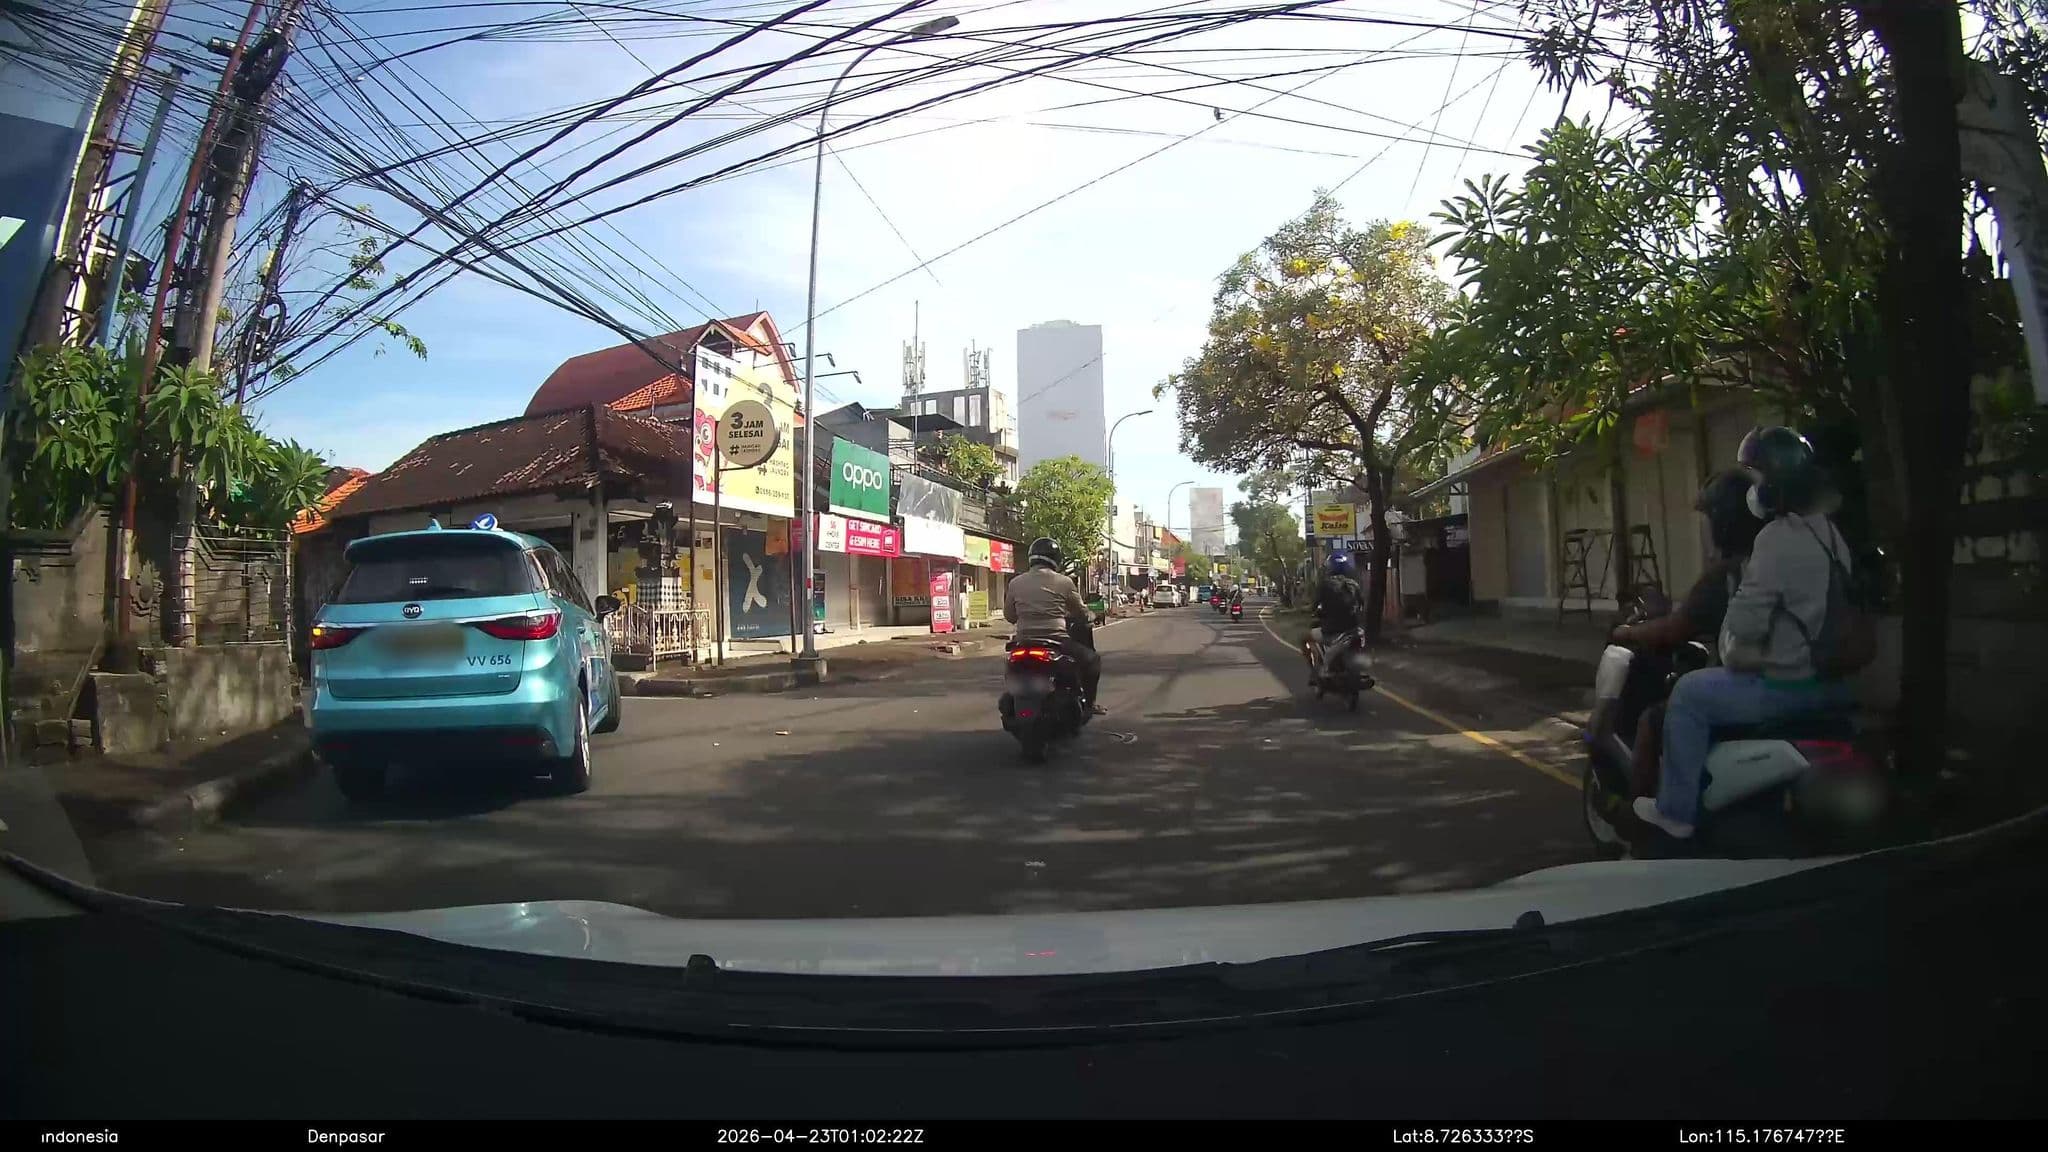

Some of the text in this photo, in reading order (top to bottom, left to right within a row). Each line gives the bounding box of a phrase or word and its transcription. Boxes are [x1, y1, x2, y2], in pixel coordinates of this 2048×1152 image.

[730, 411, 764, 430] 3 JAM
[728, 430, 764, 439] SELESAI
[842, 460, 883, 491] oppo
[848, 519, 860, 531] GET
[467, 654, 512, 667] VV 656
